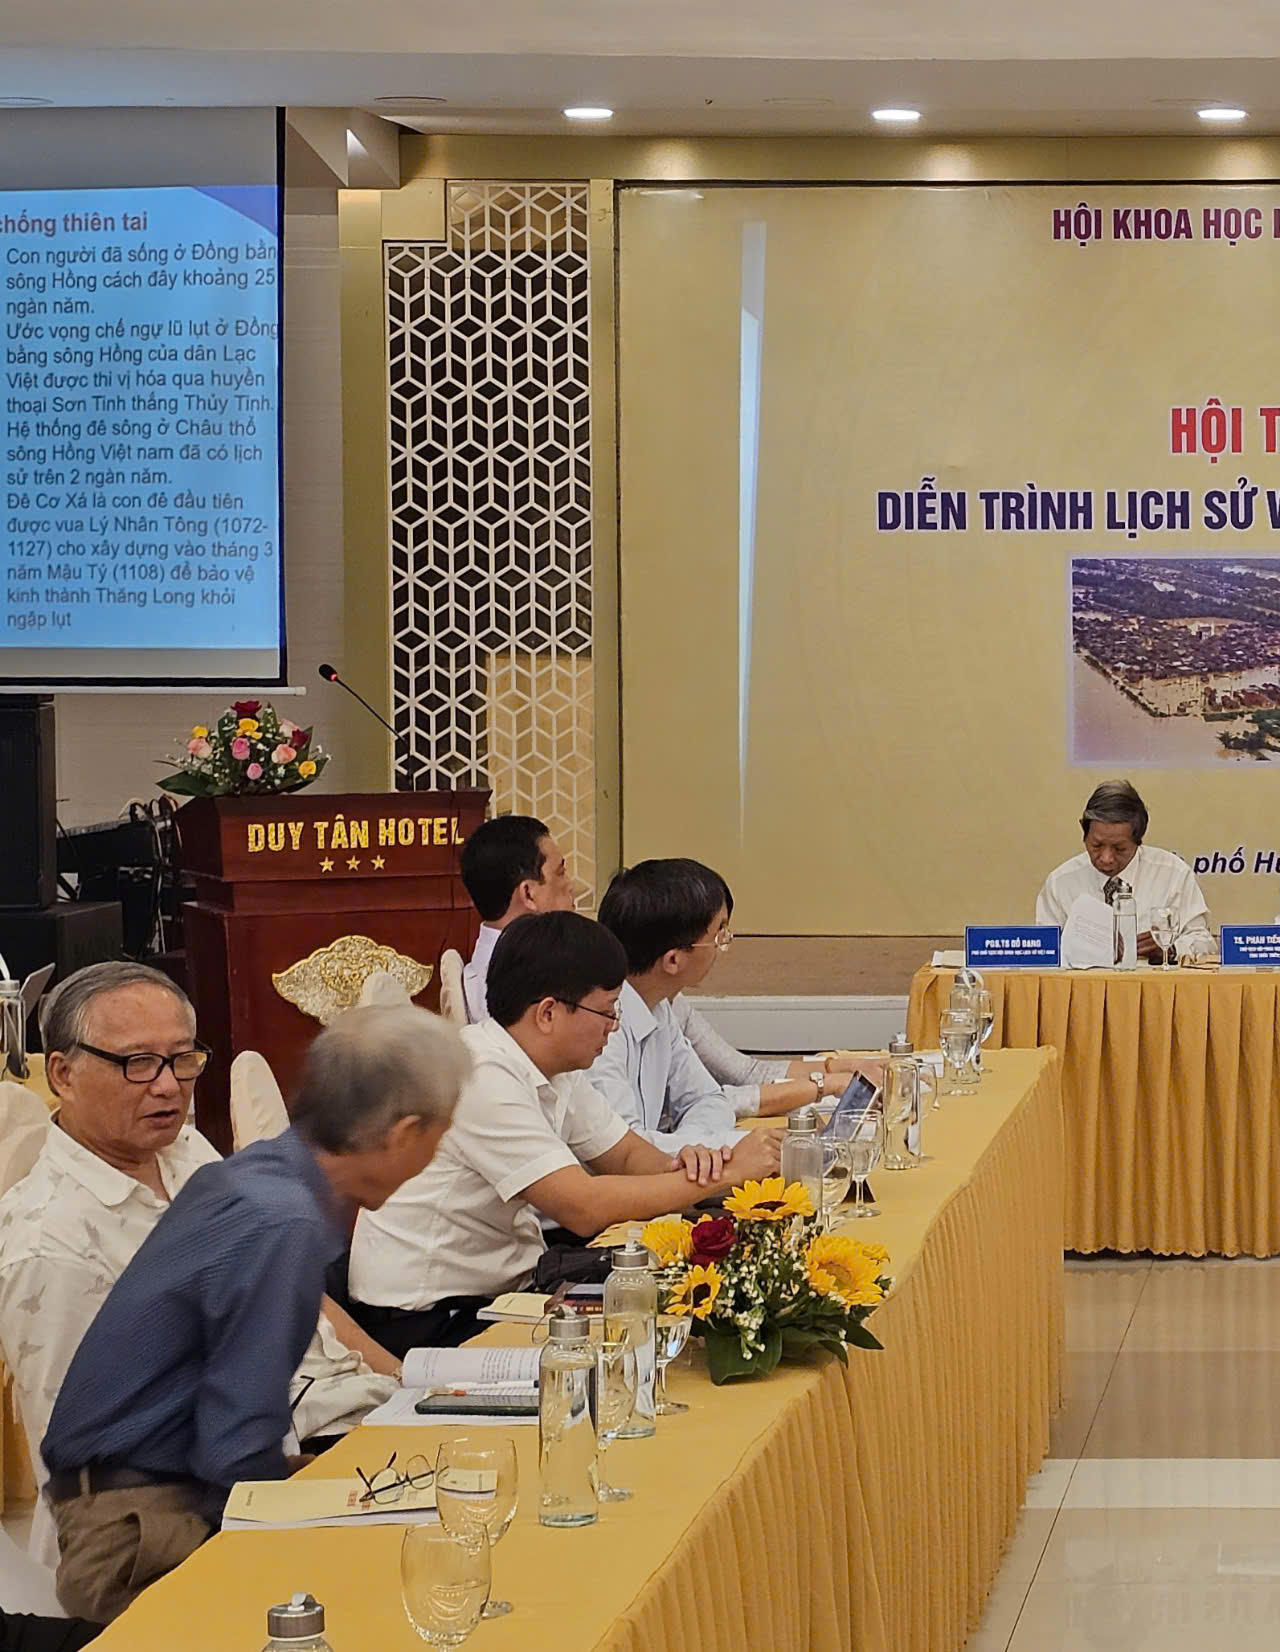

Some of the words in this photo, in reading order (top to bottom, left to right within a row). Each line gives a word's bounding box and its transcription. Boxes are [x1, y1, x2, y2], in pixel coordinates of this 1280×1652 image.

[0, 209, 56, 237] hống
[64, 212, 115, 232] thiên
[123, 212, 147, 231] tai
[1053, 202, 1102, 247] HỘI
[1113, 207, 1193, 240] KHOA
[1203, 208, 1262, 246] HỌC
[7, 248, 40, 264] Con
[46, 246, 96, 267] người
[102, 246, 122, 263] đã
[128, 242, 168, 265] sống
[174, 243, 186, 260] ở
[192, 240, 238, 264] Đồng
[7, 273, 46, 293] sông
[52, 268, 97, 292] Hồng
[103, 270, 142, 288] cách
[148, 270, 177, 290] đây
[184, 268, 248, 289] khoảng
[255, 268, 275, 285] 25
[7, 297, 47, 318] ngàn
[53, 297, 94, 314] năm.
[7, 323, 44, 339] Ước
[49, 325, 89, 342] vọng
[95, 318, 125, 338] chế
[130, 323, 163, 341] ngự
[168, 320, 182, 336] lũ
[189, 320, 209, 339] lụt
[215, 319, 228, 336] ở
[7, 344, 48, 368] bằng
[53, 347, 93, 367] sông
[99, 343, 142, 366] Hồng
[148, 344, 178, 361] của
[184, 344, 216, 361] dân
[224, 345, 256, 364] Lạc
[6, 372, 38, 391] Việt
[43, 373, 89, 391] được
[93, 371, 112, 388] thi
[118, 371, 131, 390] vị
[136, 370, 166, 387] hóa
[172, 373, 204, 389] qua
[211, 368, 265, 391] huyền
[7, 397, 47, 416] thoại
[52, 397, 86, 413] Sơn
[92, 395, 126, 412] Tinh
[132, 392, 178, 415] thắng
[184, 394, 228, 415] Thủy
[234, 395, 274, 412] Tinh.
[7, 422, 30, 440] Hệ
[36, 418, 81, 440] thống
[87, 420, 107, 436] đê
[112, 419, 151, 439] sông
[157, 418, 170, 435] ở
[176, 419, 222, 436] Châu
[229, 416, 256, 436] thổ
[1170, 398, 1242, 464] HỘI
[7, 445, 46, 465] sông
[52, 442, 95, 464] Hồng
[101, 443, 131, 463] Việt
[137, 447, 173, 460] nam
[180, 444, 200, 460] đã
[207, 444, 228, 461] có
[234, 444, 262, 464] lịch
[7, 468, 28, 485] sử
[34, 468, 65, 485] trên
[70, 469, 80, 485] 2
[85, 468, 125, 488] ngàn
[131, 468, 172, 485] năm.
[7, 493, 30, 509] Đê
[36, 493, 60, 509] Cơ
[92, 492, 106, 508] là
[112, 496, 142, 509] con
[147, 492, 168, 509] đê
[174, 489, 206, 509] đầu
[212, 492, 244, 509] tiên
[877, 477, 967, 531] DIỄN
[979, 483, 1093, 530] TRÌNH
[1106, 490, 1190, 539] LỊCH
[1204, 477, 1259, 530] SỬ
[7, 518, 51, 536] được
[55, 520, 84, 532] vua
[89, 516, 109, 536] Lý
[114, 516, 158, 532] Nhân
[163, 515, 208, 537] Tông
[214, 517, 268, 537] (1072-
[8, 540, 52, 560] 1127)
[57, 540, 86, 556] cho
[91, 540, 119, 560] xây
[125, 540, 169, 560] dựng
[174, 541, 206, 557] vào
[212, 541, 259, 562] tháng
[264, 541, 273, 557] 3
[7, 564, 42, 580] năm
[47, 564, 82, 583] Mậu
[113, 564, 165, 584] (1108)
[170, 561, 192, 581] để
[198, 565, 229, 581] bảo
[235, 565, 255, 584] vệ
[7, 588, 40, 604] kinh
[45, 587, 90, 604] thành
[153, 588, 195, 608] Long
[201, 587, 236, 605] khỏi
[51, 611, 72, 632] lụt
[247, 822, 304, 852] DUY
[314, 814, 369, 850] TÂN
[379, 817, 465, 846] HOTEL
[1193, 847, 1245, 874] phố
